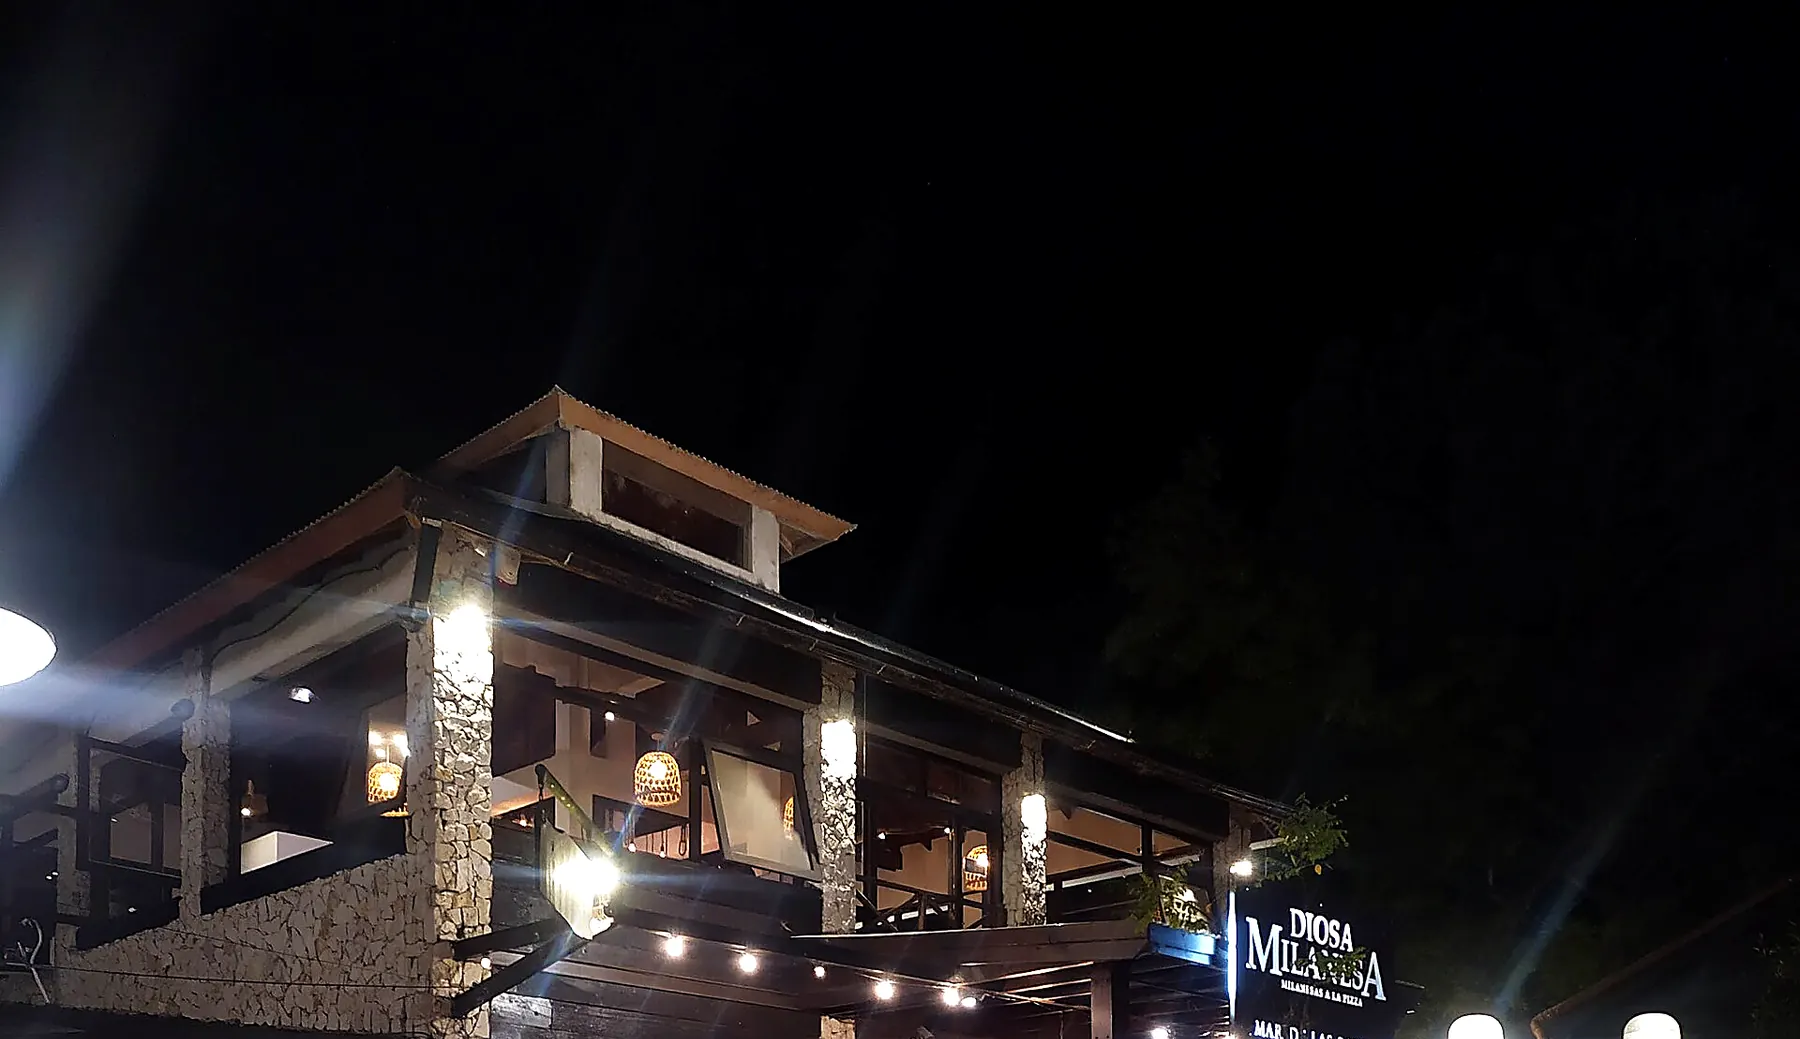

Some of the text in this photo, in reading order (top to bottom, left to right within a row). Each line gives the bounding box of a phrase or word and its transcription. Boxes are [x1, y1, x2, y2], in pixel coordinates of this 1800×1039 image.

[1289, 907, 1354, 953] DIOSA
[1281, 979, 1363, 1007] MILANESAS A LA PIZZA
[1254, 1019, 1284, 1039] MAR
